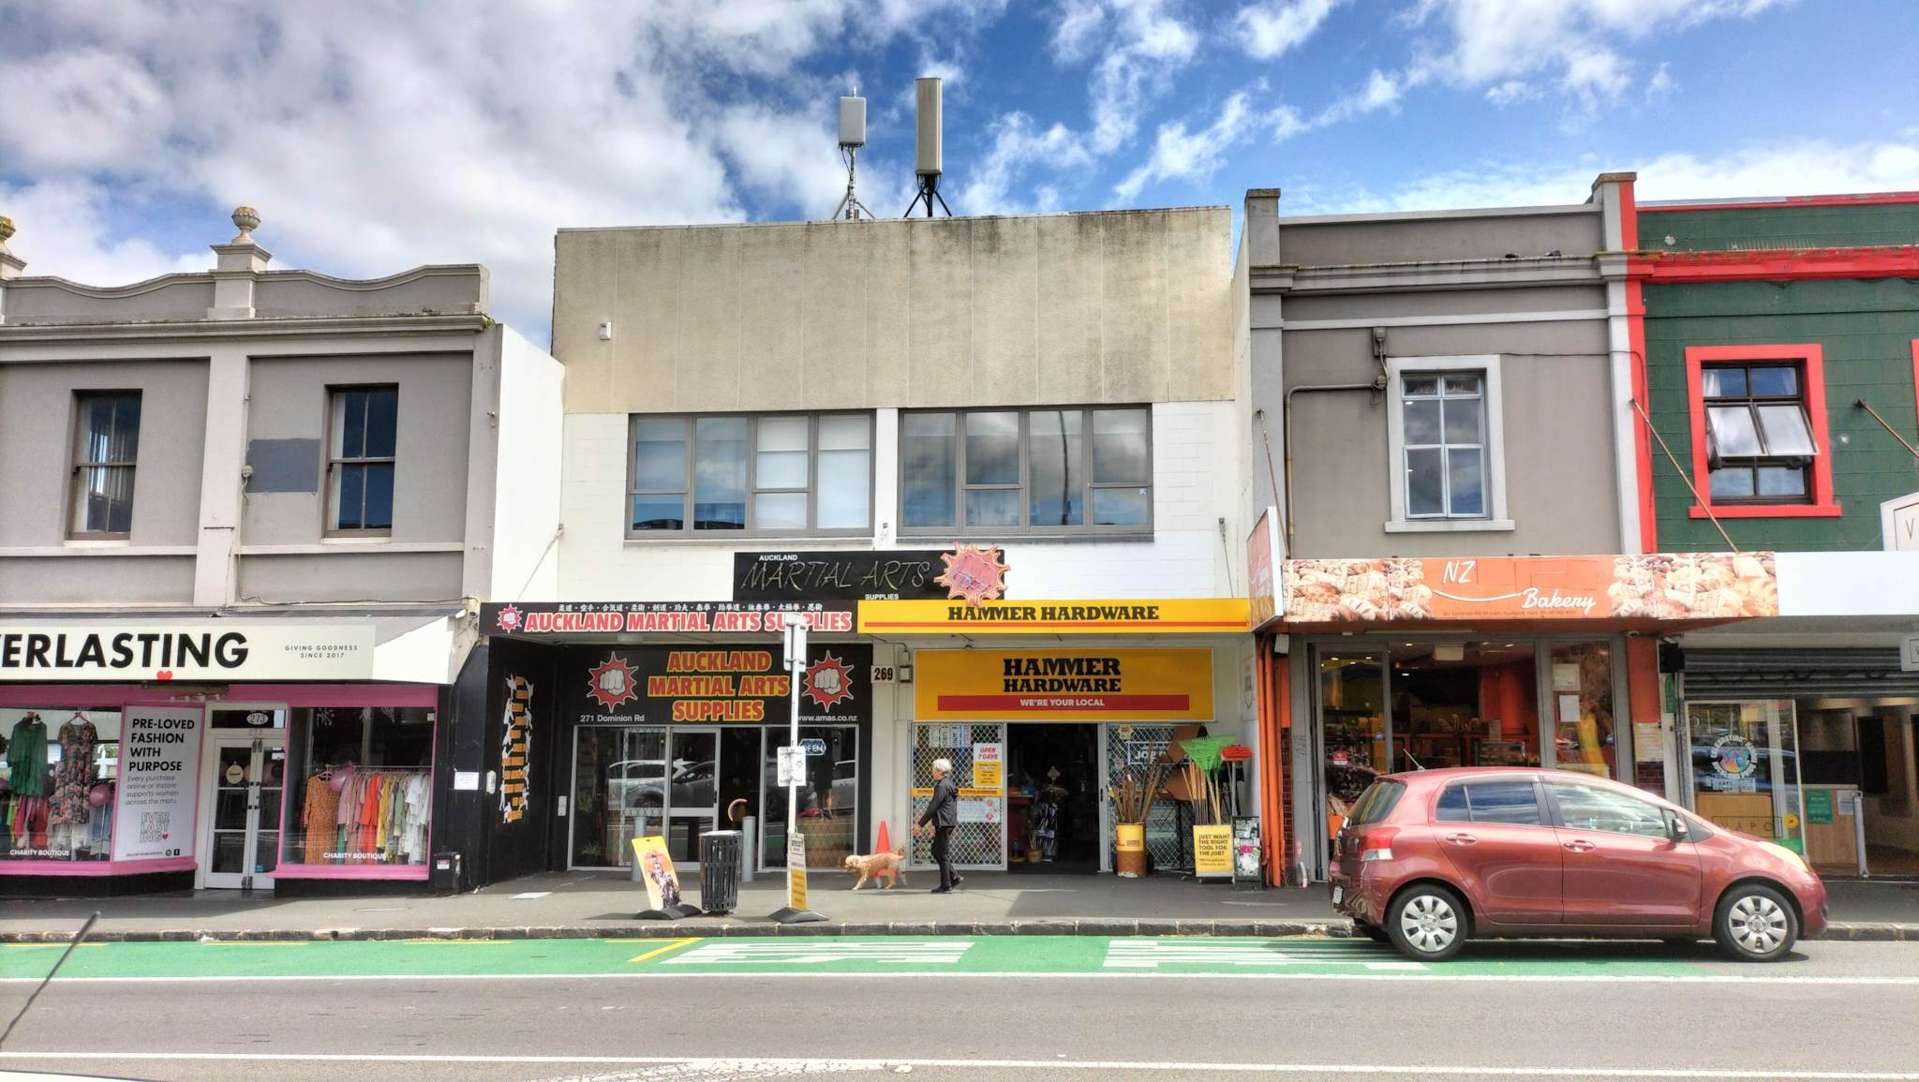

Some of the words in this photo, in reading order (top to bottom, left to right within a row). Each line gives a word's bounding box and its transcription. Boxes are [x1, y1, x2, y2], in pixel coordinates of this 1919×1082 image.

[759, 554, 798, 562] AUCKLAND
[740, 560, 852, 591] MARTIAL
[860, 560, 931, 591] ARTS
[1442, 559, 1477, 584] NZ
[1520, 587, 1597, 616] Bakery
[948, 606, 1036, 621] HAMMER
[1040, 606, 1159, 621] HARDWARE
[524, 611, 624, 633] AUCKLAND
[626, 611, 709, 632] MARTIAL
[712, 611, 762, 632] ARTS
[764, 611, 852, 632] SUPLIES
[0, 632, 249, 669] ERLASTING
[667, 651, 772, 672] AUCKLAND
[1003, 658, 1121, 676] HAMMER
[874, 667, 893, 680] 269
[648, 675, 736, 697] MARTIAL
[738, 675, 790, 697] ARTS
[1003, 678, 1121, 693] HARDWARE
[1020, 698, 1048, 707] WE'RE
[1049, 698, 1074, 707] YOUR
[1075, 698, 1105, 707] LOCAL
[580, 714, 594, 722] 271
[597, 714, 632, 722] Dominion
[634, 714, 645, 722] Rd
[672, 700, 764, 721] SUPPLIES
[132, 718, 195, 730] PRE-LOVED
[131, 733, 184, 743] FASHION
[130, 747, 161, 757] WITH
[129, 761, 182, 772] PURPOSE
[38, 849, 70, 857] BOUTIQUE
[352, 853, 387, 861] BOUTIQUE
